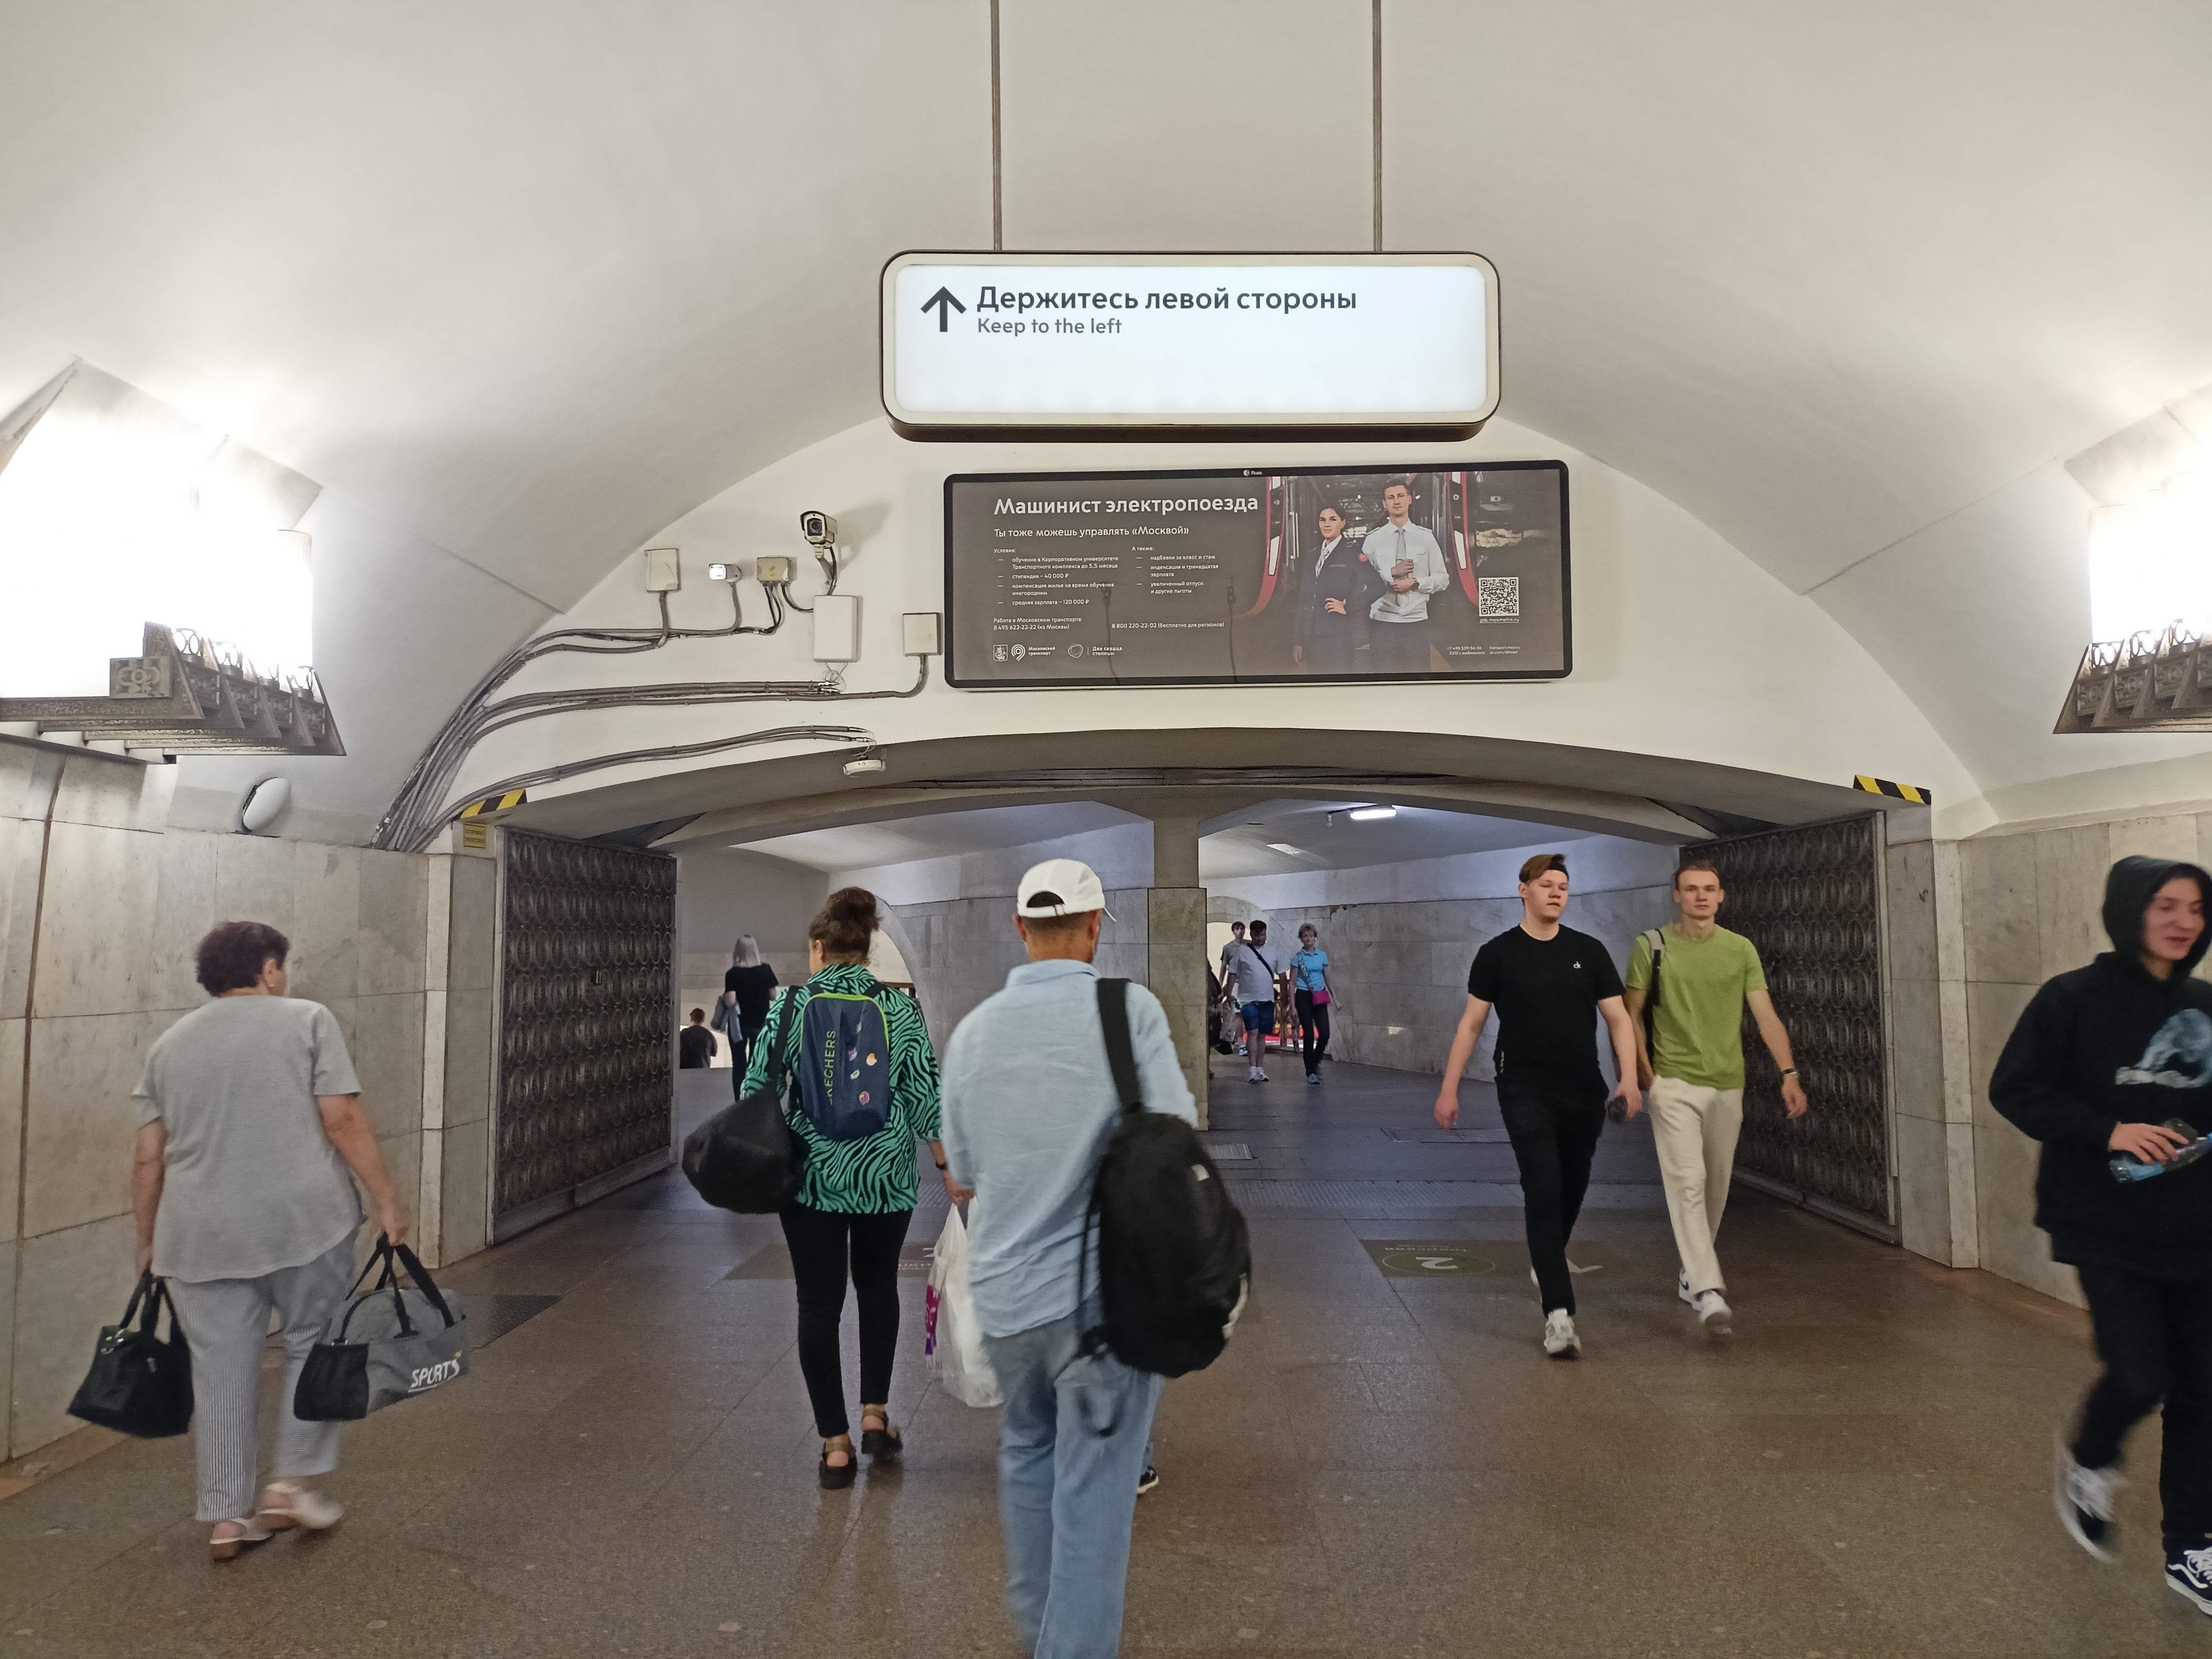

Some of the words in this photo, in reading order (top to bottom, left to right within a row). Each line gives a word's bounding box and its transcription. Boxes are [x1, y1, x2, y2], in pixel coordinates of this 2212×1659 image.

[977, 287, 1138, 314] Держитесь
[1145, 288, 1228, 309] левой
[1237, 293, 1356, 314] стороны
[978, 318, 1025, 336] Keep
[1031, 319, 1049, 333] to
[1055, 318, 1084, 333] the
[1091, 318, 1122, 333] left
[994, 498, 1101, 514] Машинист
[1106, 498, 1258, 515] электропоезда
[1080, 529, 1129, 537] управлять
[1132, 526, 1188, 534] «Москвой»
[825, 1031, 835, 1106] ECHERS
[1416, 1257, 1458, 1269] 2
